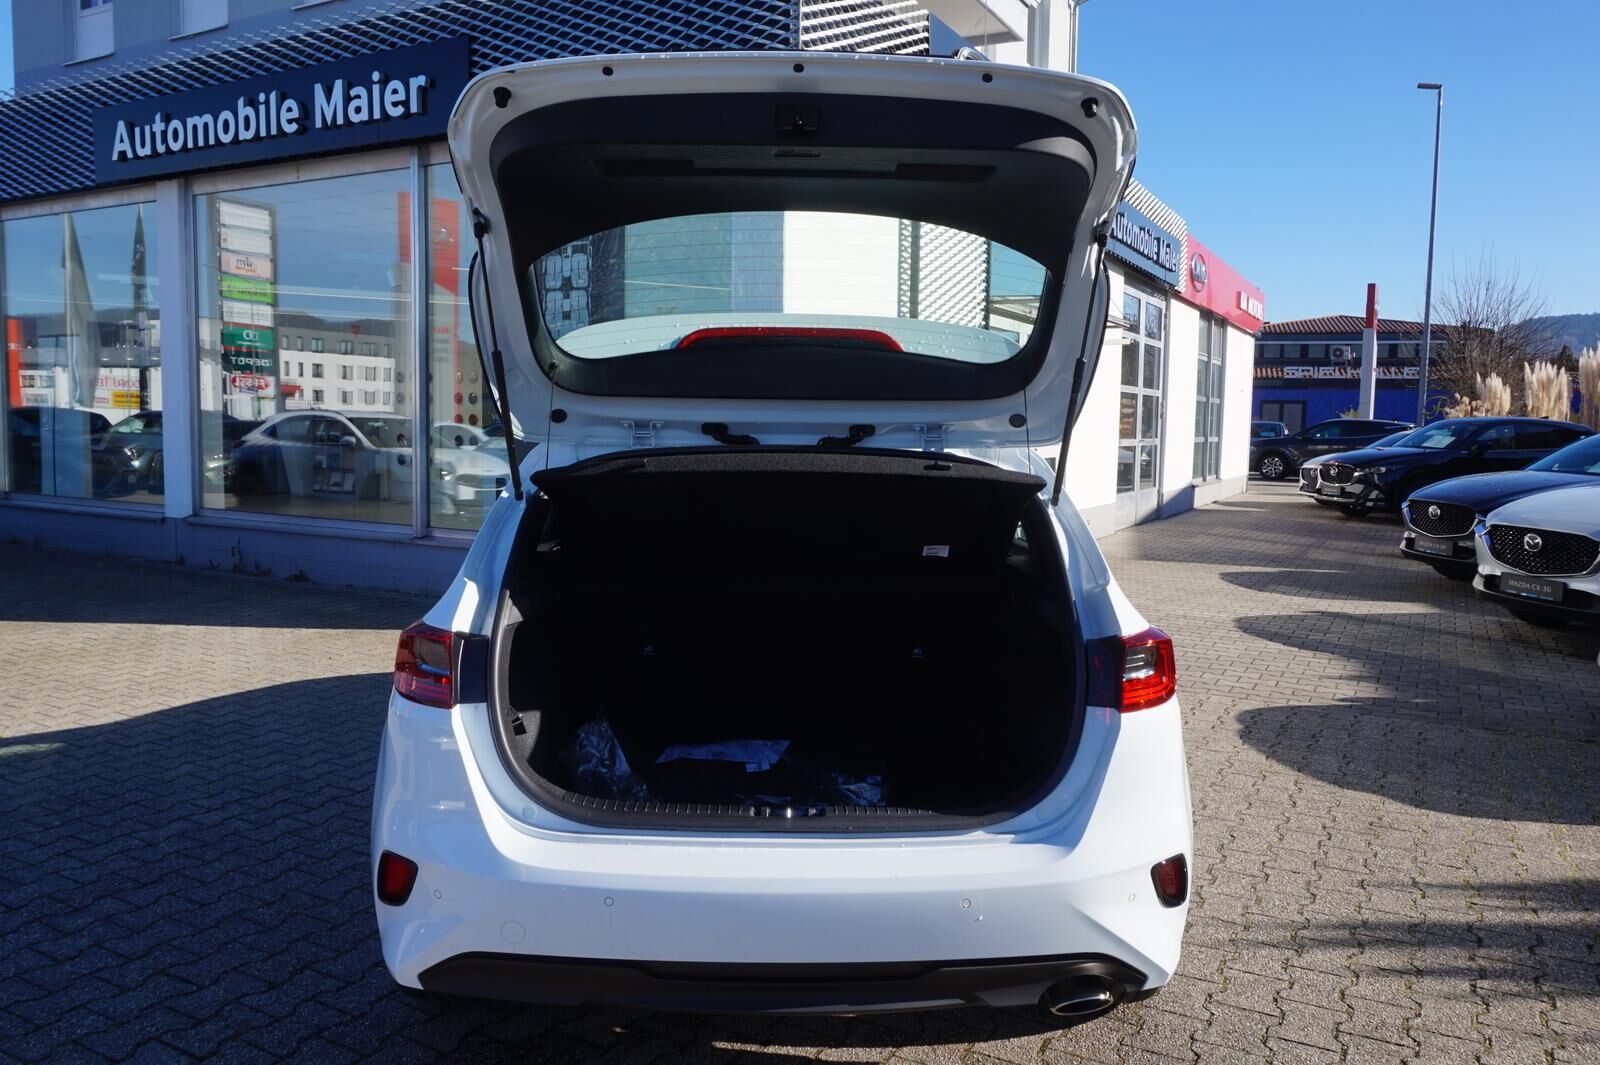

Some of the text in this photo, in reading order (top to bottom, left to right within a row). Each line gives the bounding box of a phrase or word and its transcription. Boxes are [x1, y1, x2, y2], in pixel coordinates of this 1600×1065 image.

[111, 70, 427, 161] Automobile Maier
[1110, 212, 1179, 272] Automobile Maier
[1283, 366, 1420, 379] SPIELHLLE
[1508, 579, 1552, 593] MAZDA CX-30
